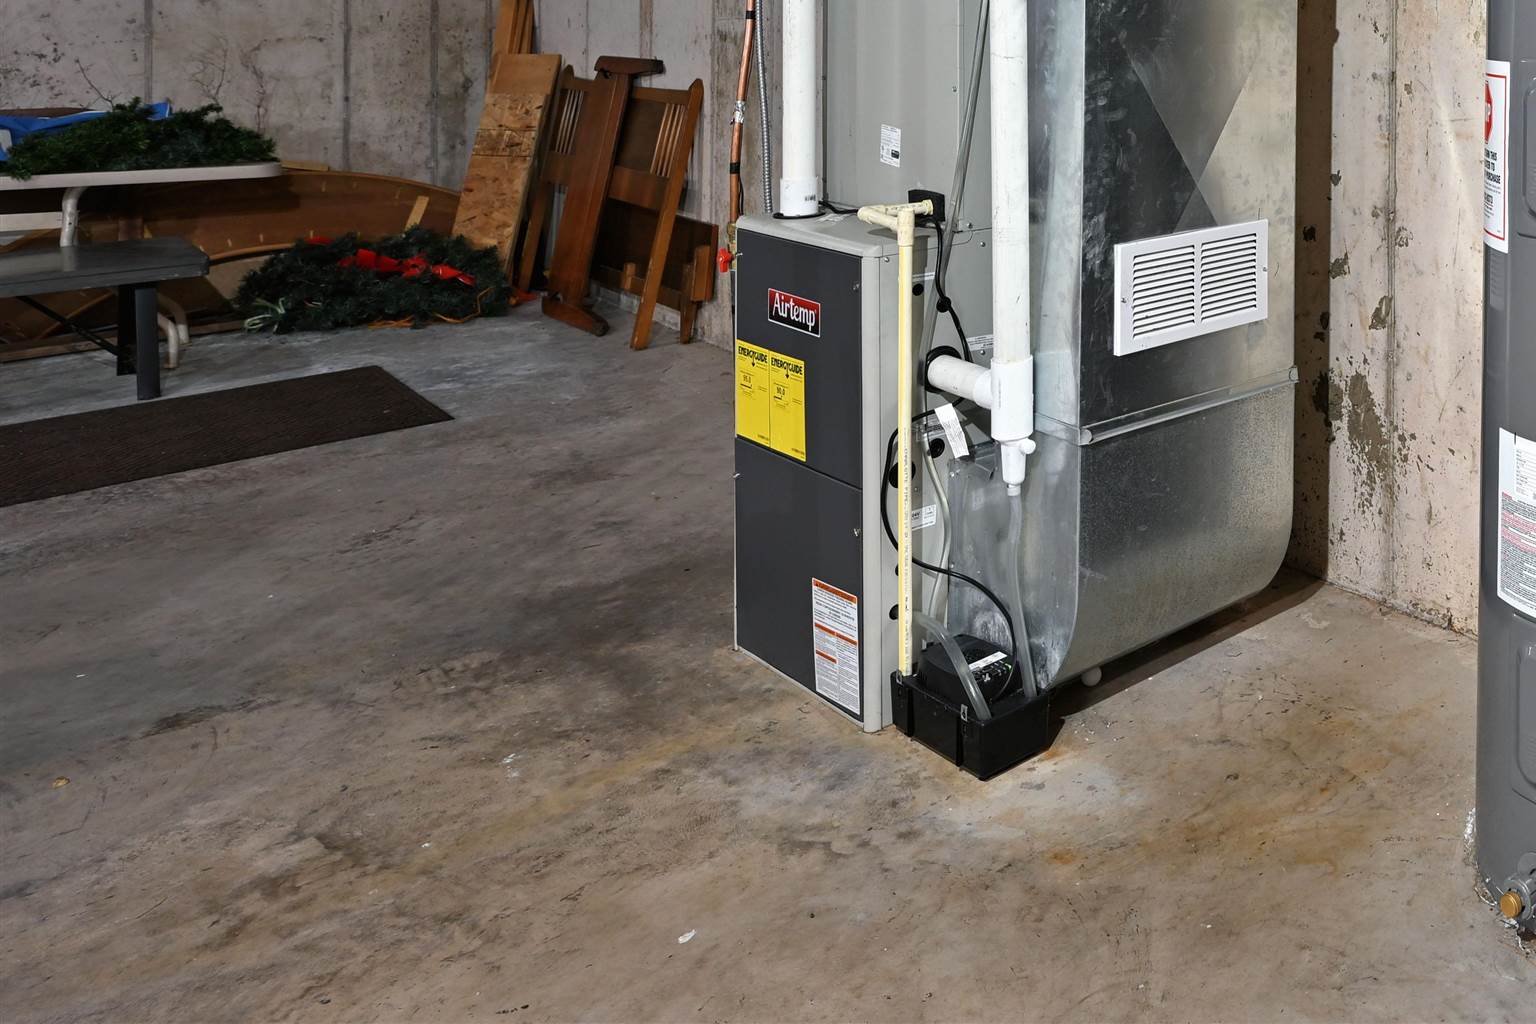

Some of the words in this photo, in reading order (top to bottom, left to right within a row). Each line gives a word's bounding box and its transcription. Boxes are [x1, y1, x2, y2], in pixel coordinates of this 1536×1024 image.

[773, 292, 816, 332] Airtemp
[738, 346, 768, 364] ENERGYGUIDE
[771, 357, 802, 376] ENERGYGUIDE
